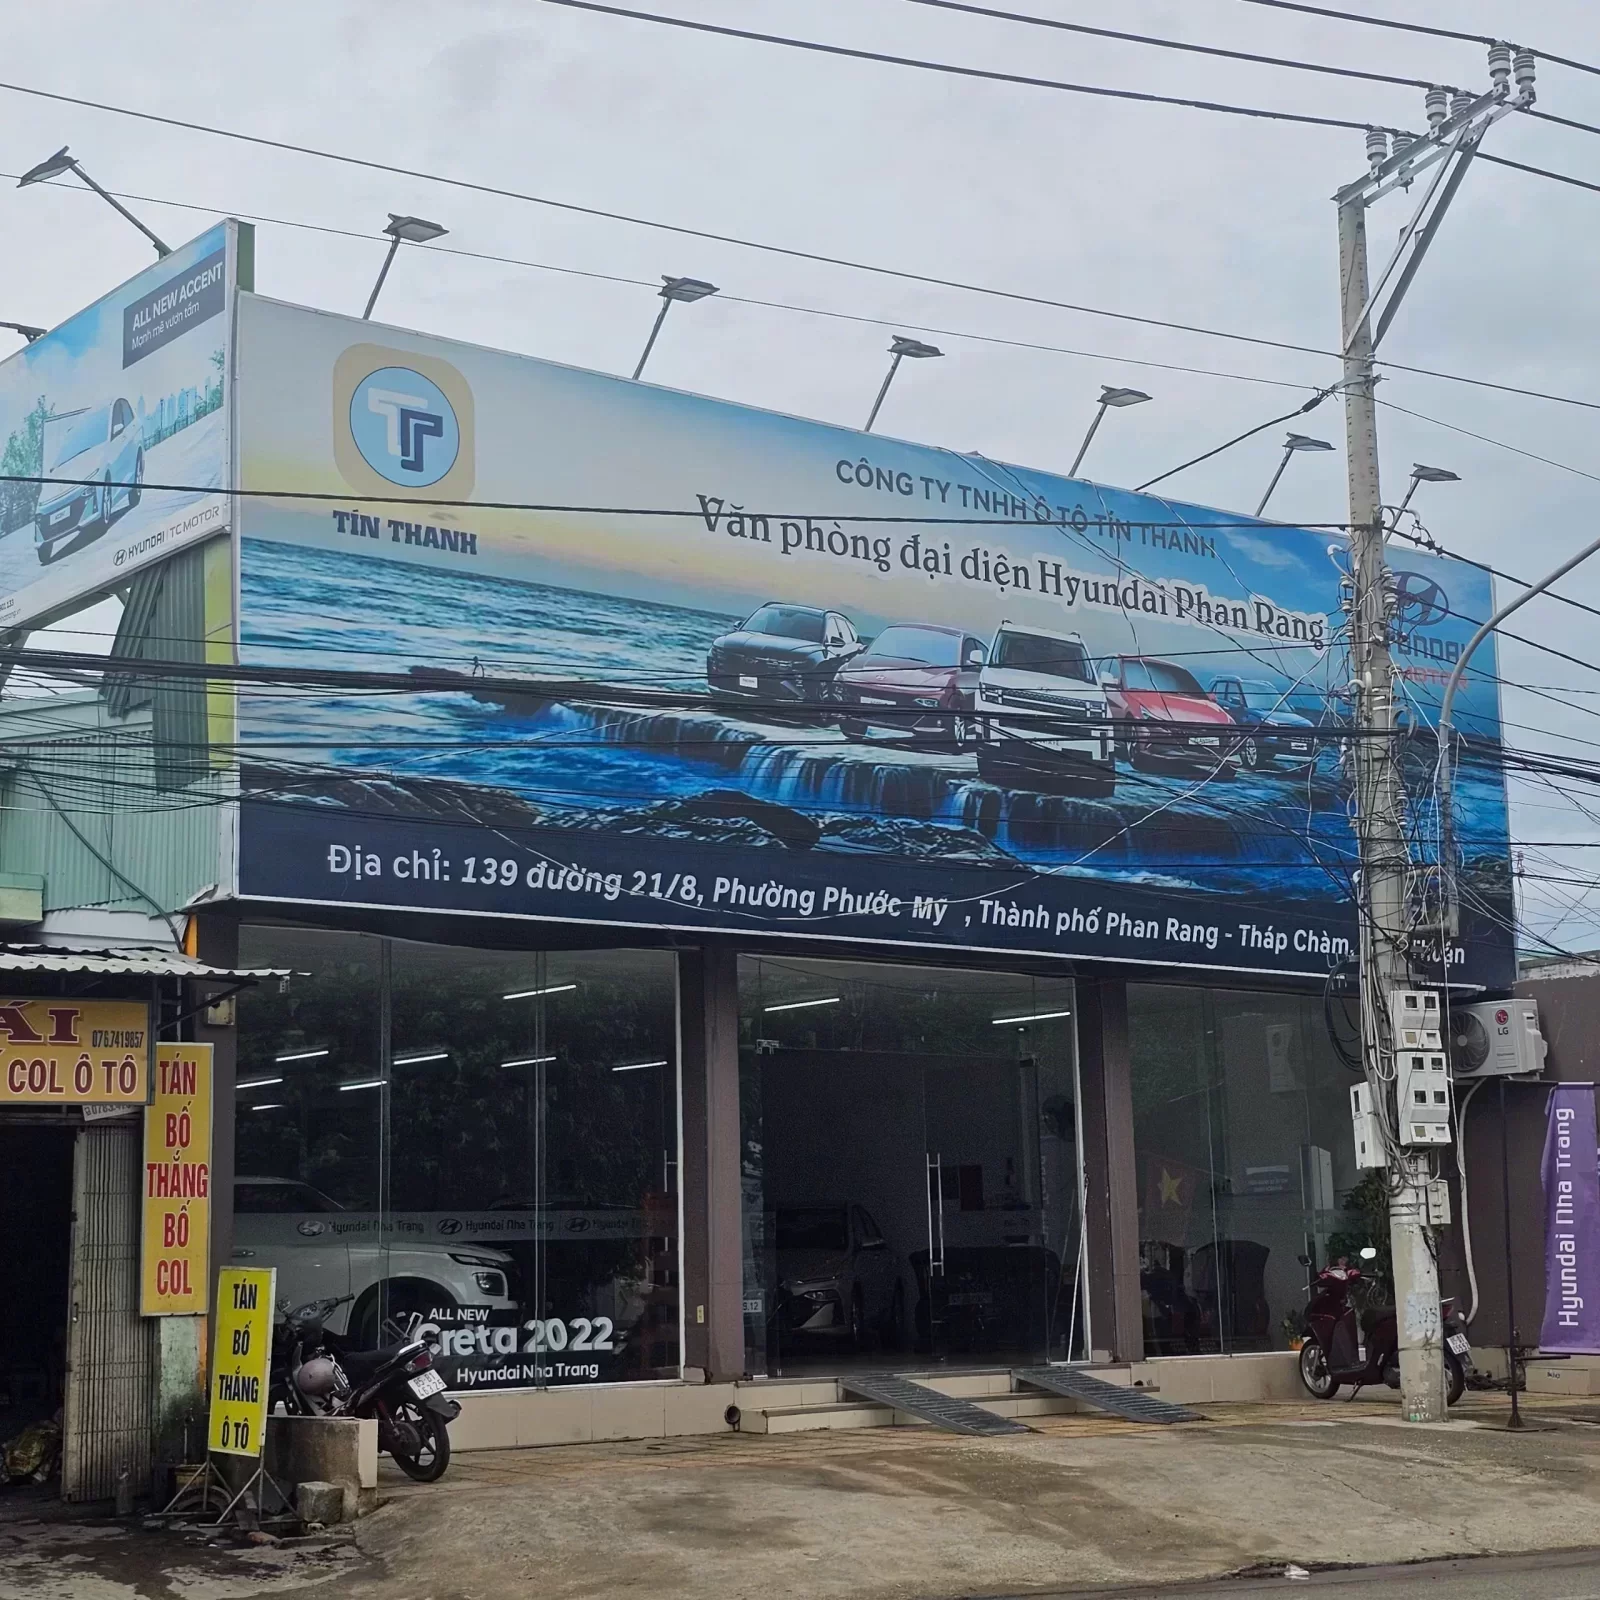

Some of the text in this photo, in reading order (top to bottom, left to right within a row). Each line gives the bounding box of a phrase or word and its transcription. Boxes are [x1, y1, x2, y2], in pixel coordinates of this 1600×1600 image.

[132, 261, 224, 331] ALL NEW ACCENT
[836, 457, 1215, 558] CÔNG TY TNHH Ô TÔ TÍN THANH
[128, 506, 220, 559] HYUNDAI TC MOTOR
[333, 509, 477, 555] TÍN THANH
[696, 494, 1324, 650] Văn phòng đại diện Hyundai Phan Rang
[327, 844, 382, 880] Địa
[393, 848, 450, 881] chỉ:
[461, 857, 518, 886] 139
[526, 861, 622, 900] đường
[630, 870, 704, 906] 21/8,
[713, 877, 815, 915] Phường
[822, 887, 901, 917] Phước
[980, 899, 1050, 929] Thành
[1055, 906, 1102, 935] phố
[1106, 912, 1159, 939] Phan
[1165, 918, 1219, 949] Rang
[1238, 924, 1288, 954] Tháp
[1497, 1027, 1509, 1036] LG
[8, 1052, 137, 1095] COL Ô TÔ
[159, 1053, 197, 1095] TÁN
[165, 1100, 192, 1148] BỐ
[146, 1150, 209, 1198] THẮNG
[163, 1200, 191, 1248] BỐ
[1555, 1107, 1583, 1326] Hyundai Nha Trang
[156, 1259, 193, 1296] COL
[233, 1278, 258, 1309] TÁN
[413, 1316, 614, 1356] Creta 2022
[429, 1308, 489, 1321] ALL NEW
[232, 1320, 252, 1355] BỐ
[219, 1365, 259, 1403] THẮNG
[457, 1361, 599, 1385] Hyundai Nha Trang
[222, 1416, 250, 1449] Ô TÔ
